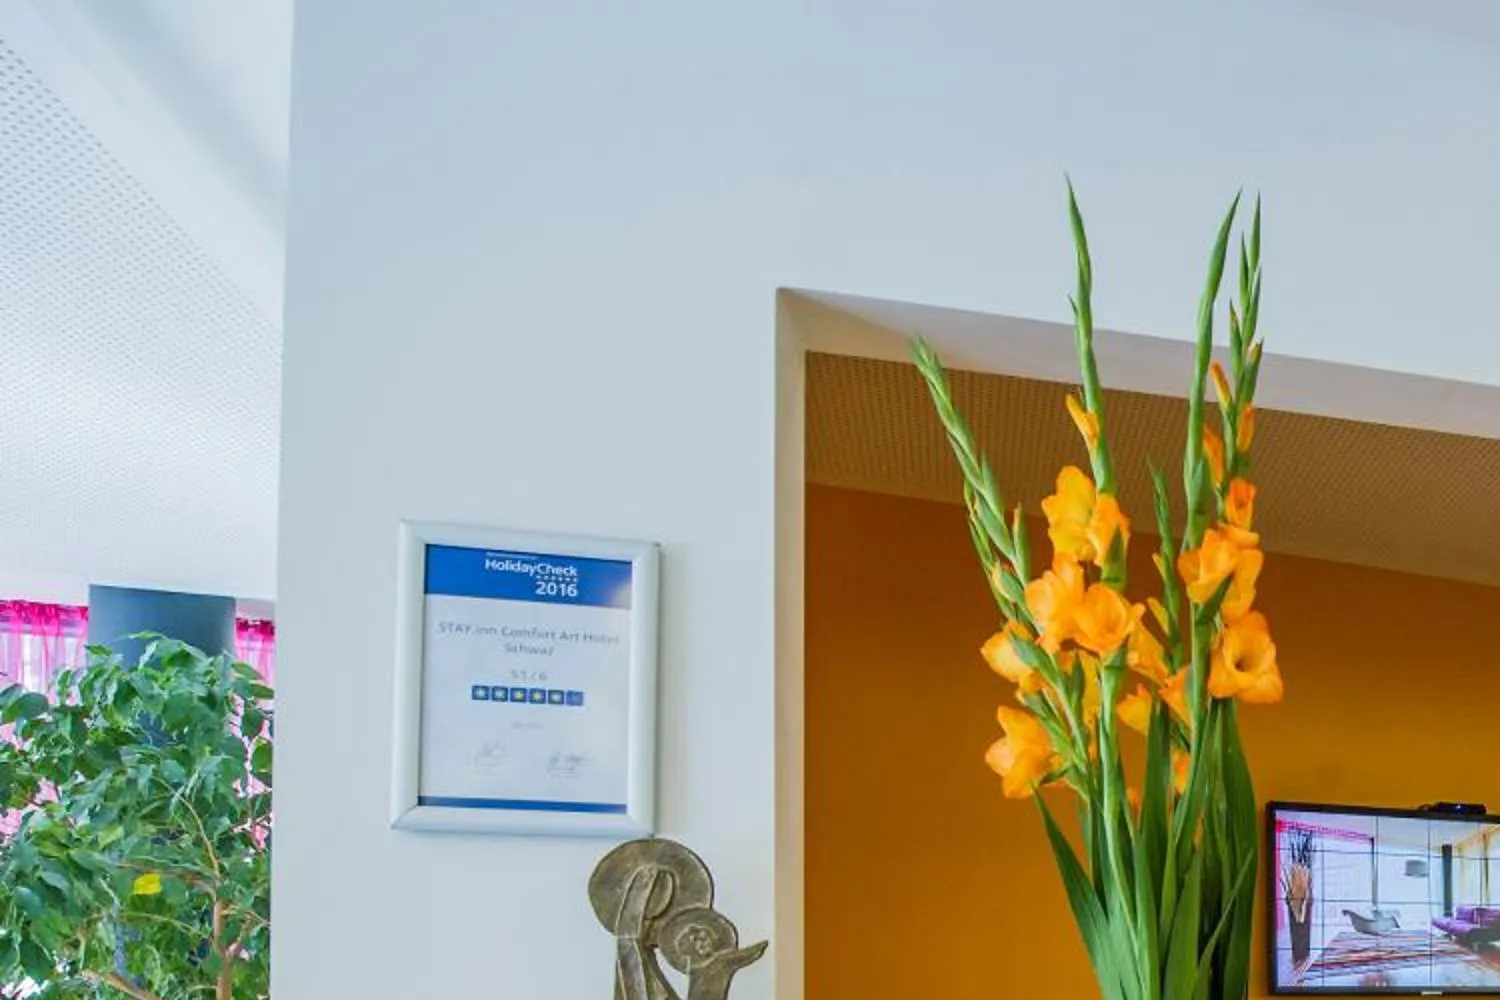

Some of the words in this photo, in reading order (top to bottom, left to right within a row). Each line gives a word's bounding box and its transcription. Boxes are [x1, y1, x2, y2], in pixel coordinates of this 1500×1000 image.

[485, 558, 578, 577] HolidayCheck
[535, 581, 578, 597] 2016
[501, 625, 556, 641] Comfort
[560, 629, 580, 643] Art
